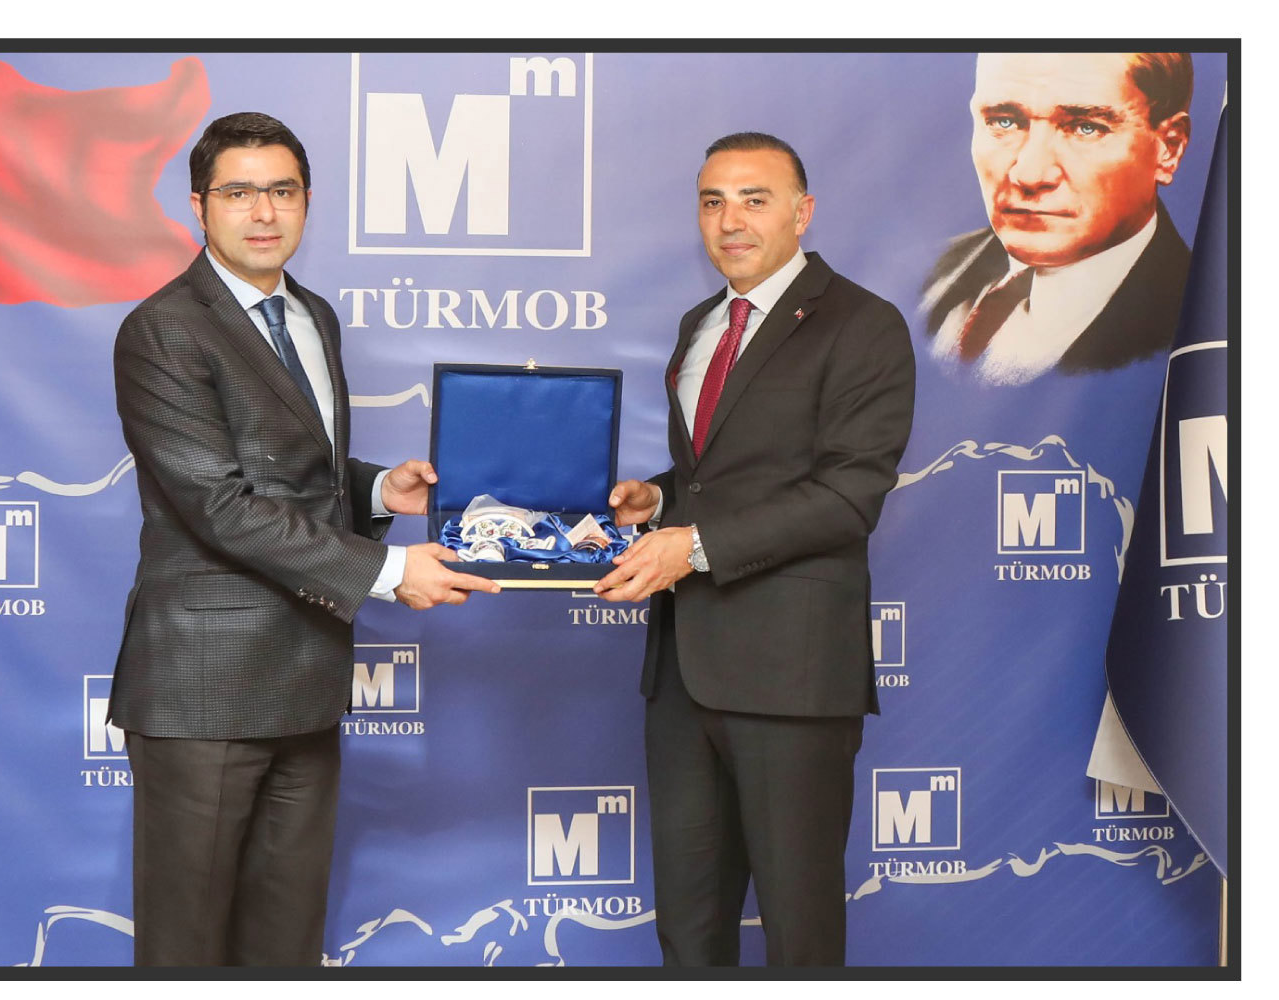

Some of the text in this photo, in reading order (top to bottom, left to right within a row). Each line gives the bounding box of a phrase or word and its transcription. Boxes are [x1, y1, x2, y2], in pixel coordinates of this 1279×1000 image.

[339, 277, 608, 330] TÜRMOB
[994, 561, 1091, 581] TÜRMOB
[1160, 574, 1227, 620] TÜ
[341, 718, 425, 736] TÜRMOB
[81, 766, 134, 787] TÜR
[1092, 825, 1175, 842] TÜRMOB
[869, 858, 967, 879] TÜRMOB
[524, 893, 642, 917] TÜRMOB
